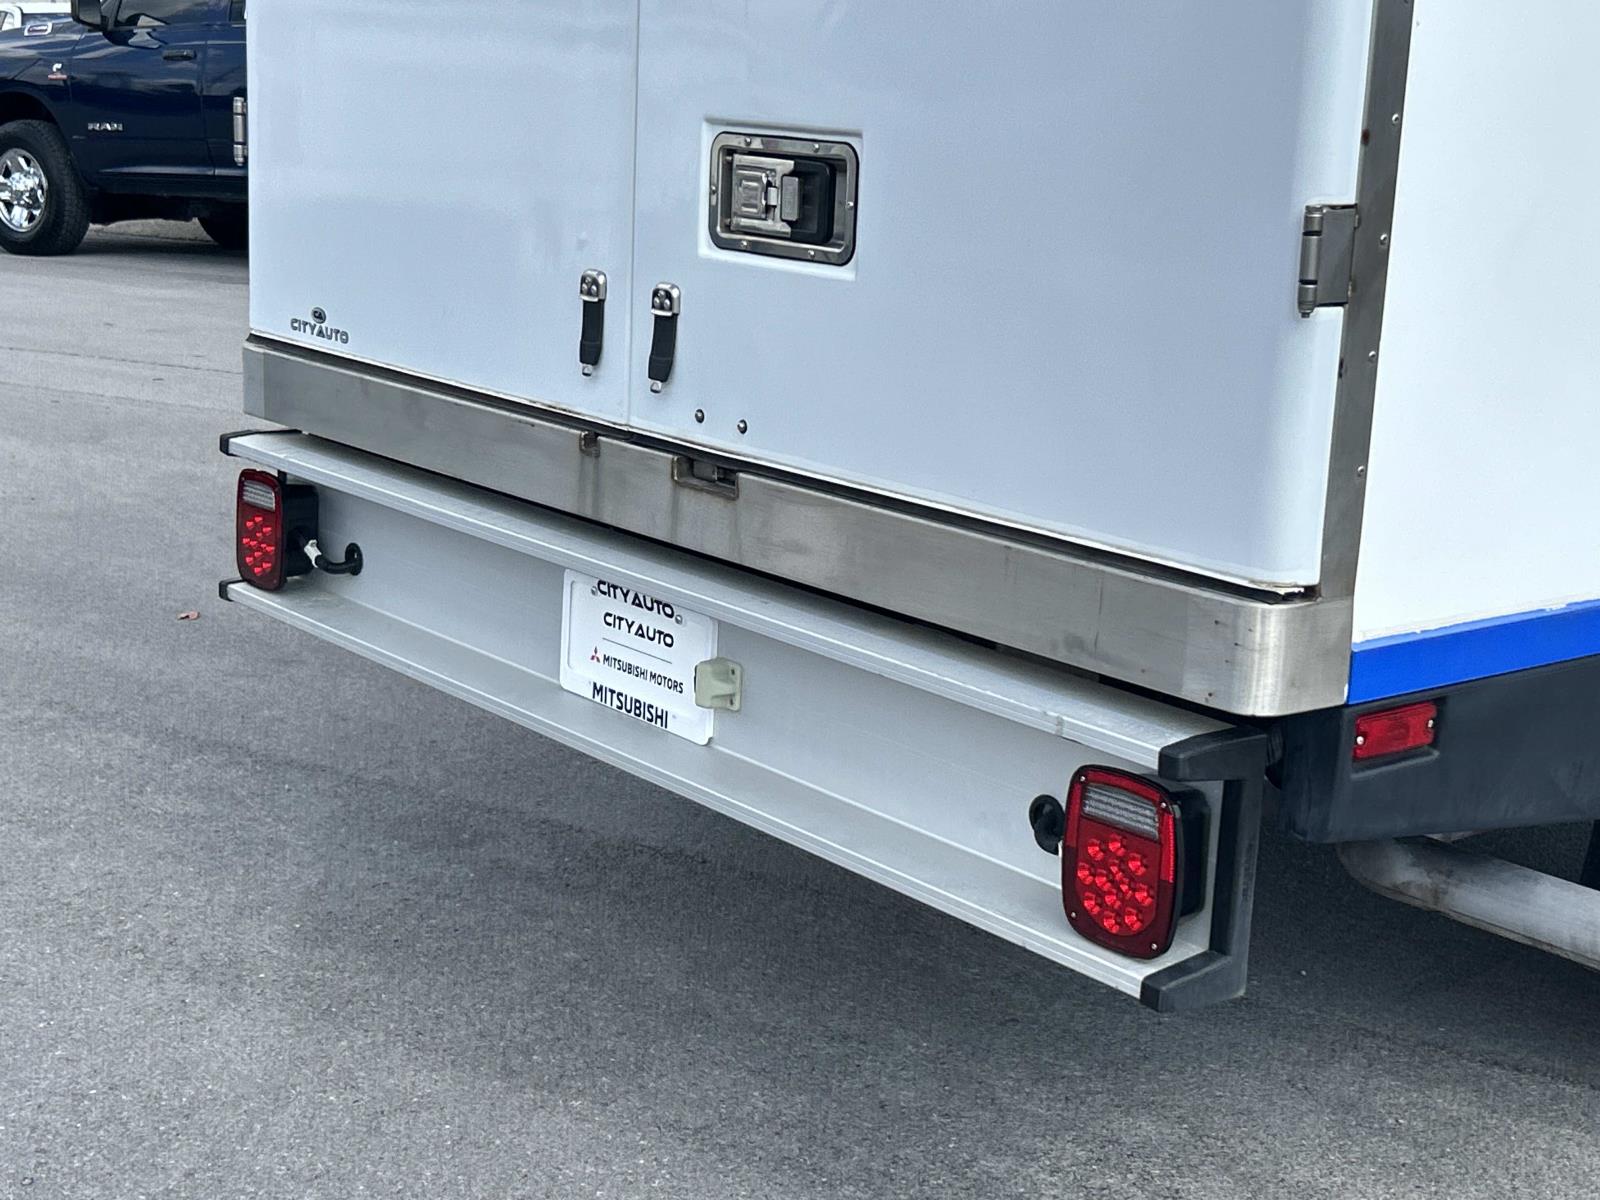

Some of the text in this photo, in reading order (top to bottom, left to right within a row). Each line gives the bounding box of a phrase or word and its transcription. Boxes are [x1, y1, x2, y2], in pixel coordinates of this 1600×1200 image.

[87, 122, 123, 131] RAM
[290, 318, 349, 344] CITYAUTO
[603, 612, 674, 648] CITYAUTO
[603, 654, 683, 694] MITSUBISHI MOTORS
[592, 681, 668, 728] MITSUBISHI
